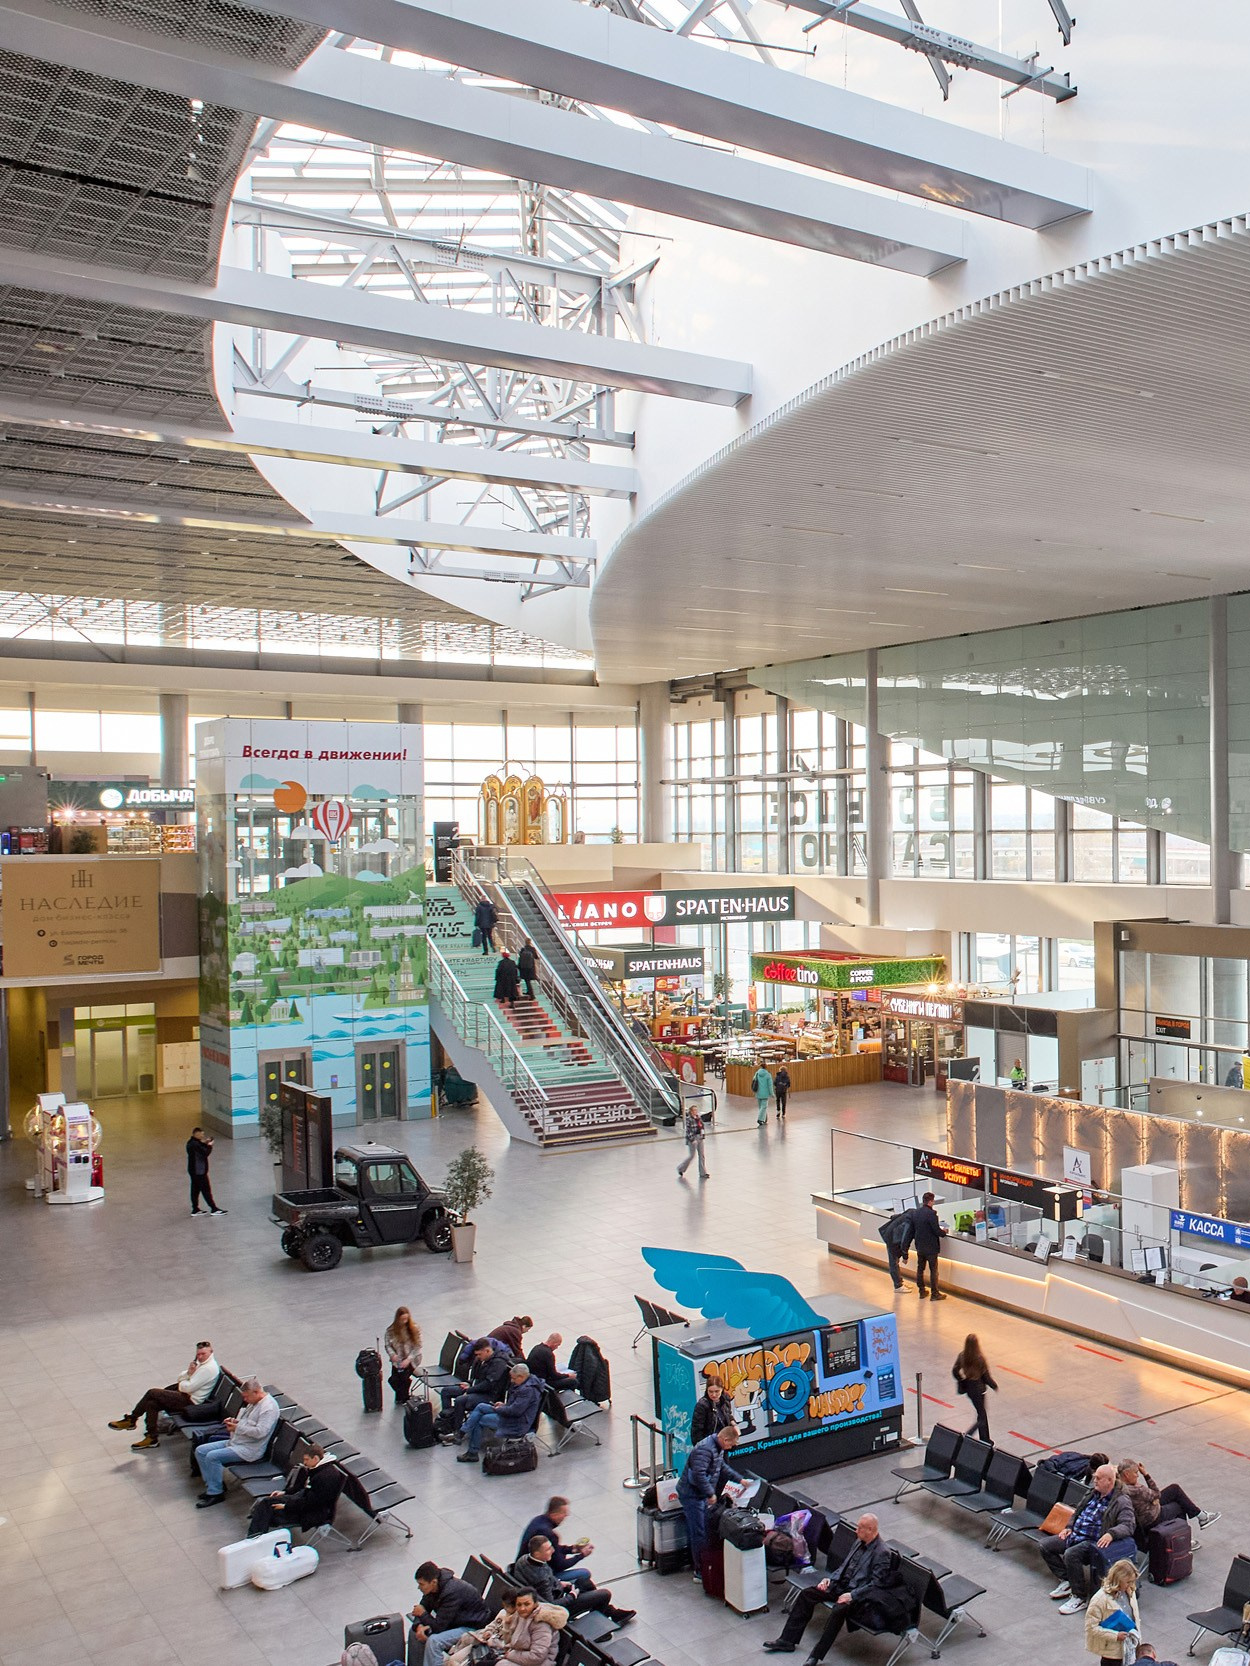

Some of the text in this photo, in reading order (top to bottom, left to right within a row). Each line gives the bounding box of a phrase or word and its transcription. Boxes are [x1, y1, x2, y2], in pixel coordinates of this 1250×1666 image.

[242, 745, 407, 761] Всегда в движении!
[126, 789, 194, 804] ДОБЫЧА
[20, 895, 144, 911] НАСЛЕДИЕ
[558, 900, 637, 920] LIANO
[32, 913, 131, 923] дом бизнес-класса
[764, 961, 819, 984] coffeetino
[849, 969, 874, 977] COFFEE
[890, 997, 925, 1016] СУВЕНИРЫ
[944, 1171, 968, 1184] УСЛУГИ
[1189, 1218, 1225, 1238] КАССА
[757, 1437, 787, 1450] Крылья
[788, 1433, 802, 1442] для
[803, 1426, 830, 1438] вашего
[830, 1410, 883, 1431] производства!
